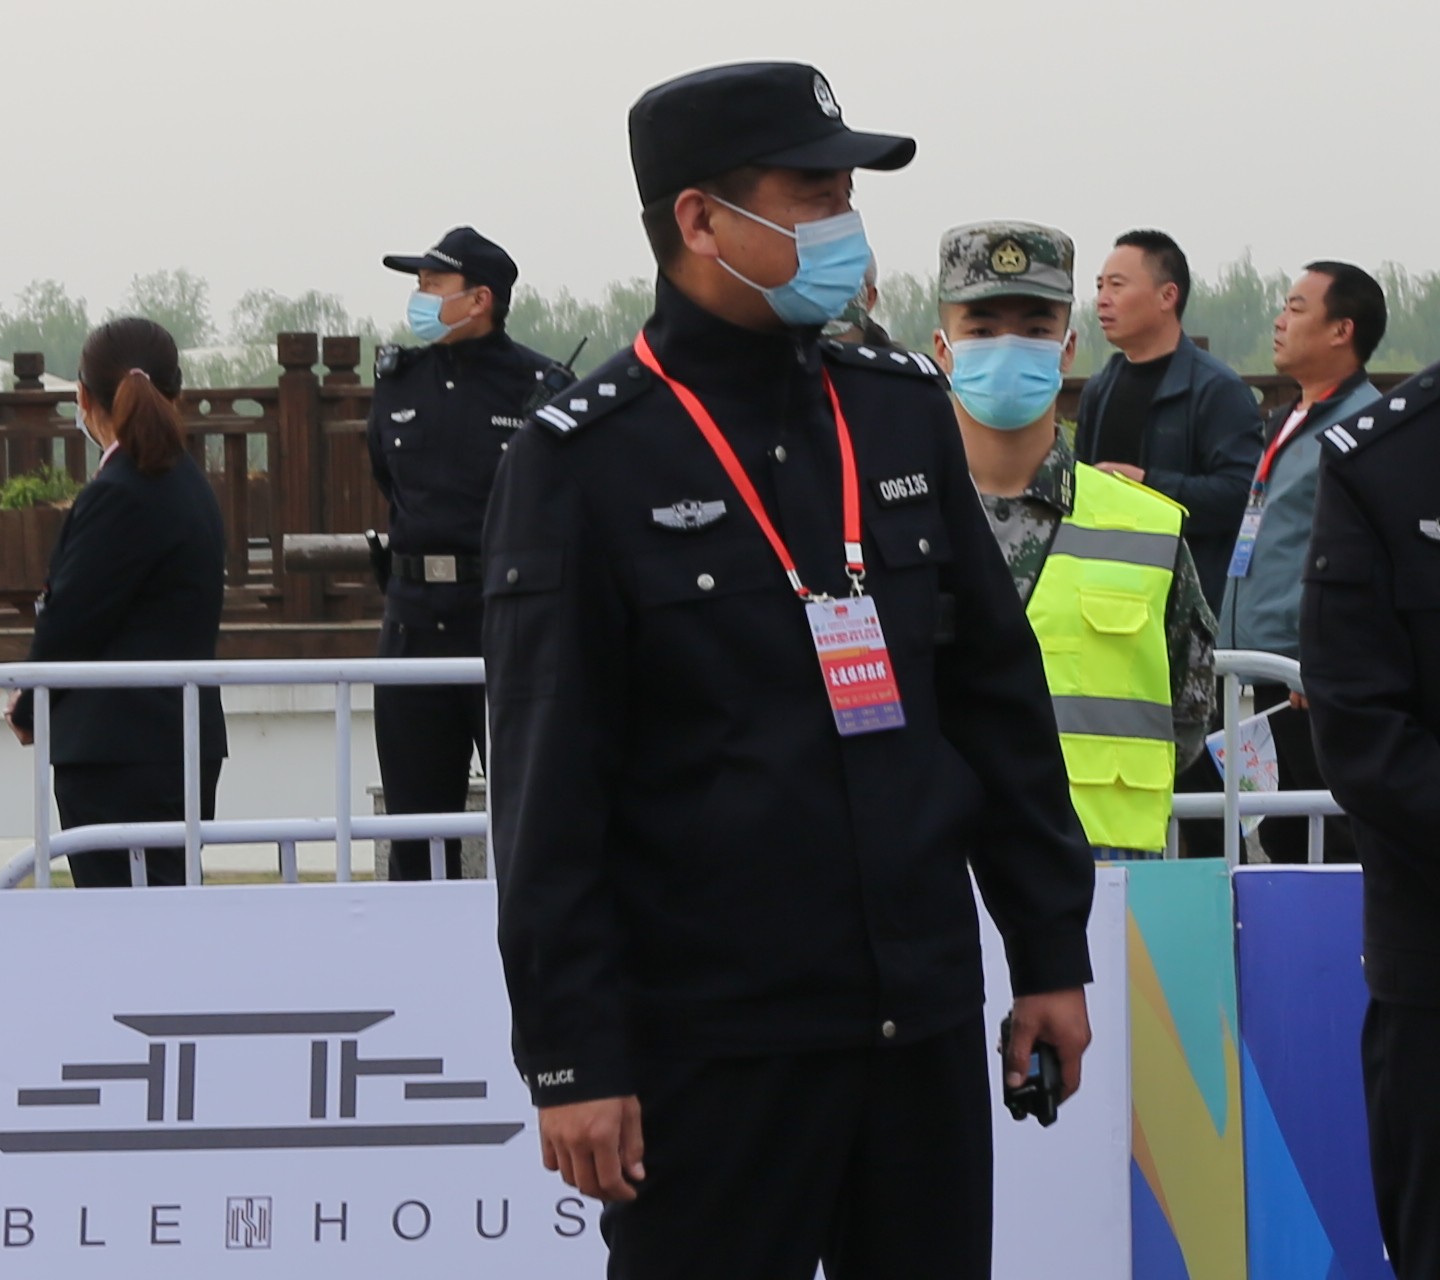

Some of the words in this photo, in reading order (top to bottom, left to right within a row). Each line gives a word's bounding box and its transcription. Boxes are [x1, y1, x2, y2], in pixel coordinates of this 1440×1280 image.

[879, 472, 929, 501] 006135
[537, 1068, 575, 1088] POLICE
[314, 1197, 587, 1244] HOUS
